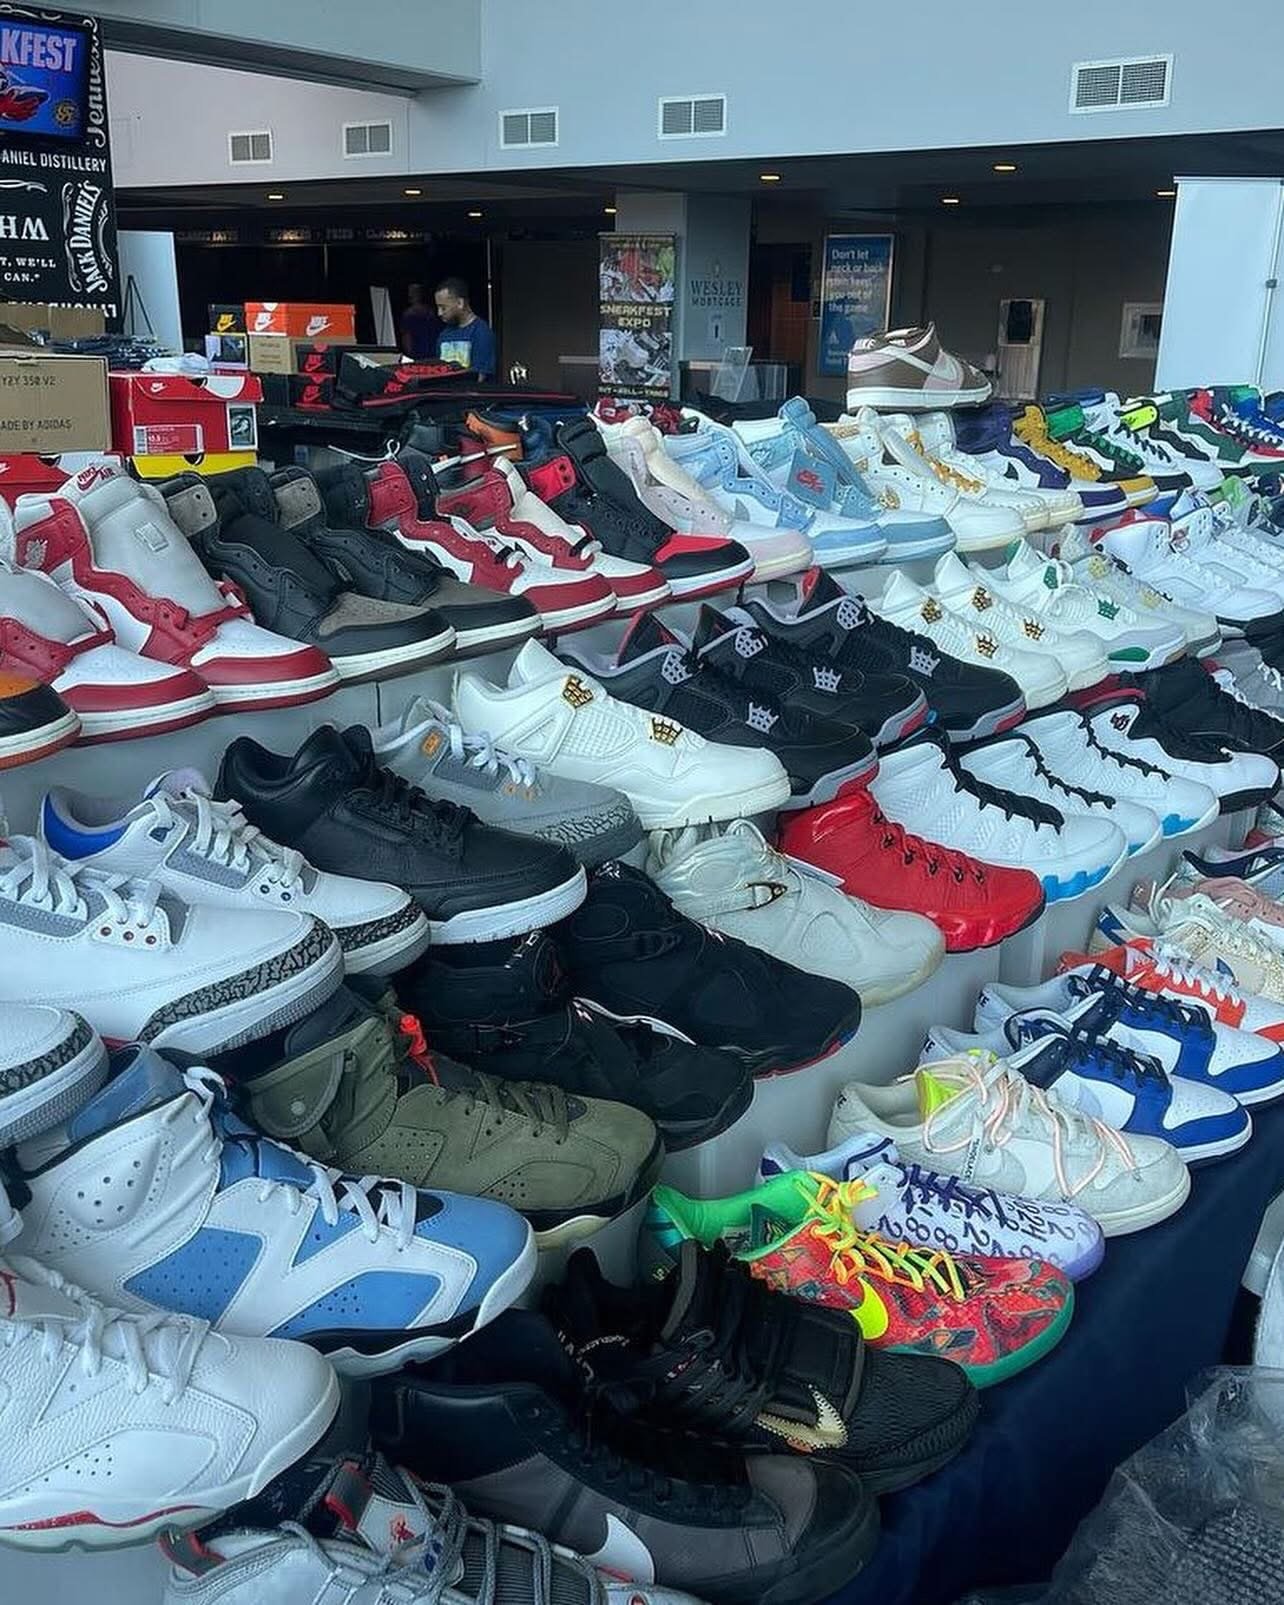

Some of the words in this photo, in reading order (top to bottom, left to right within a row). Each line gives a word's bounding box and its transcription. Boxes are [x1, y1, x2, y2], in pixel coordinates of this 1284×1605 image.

[1, 28, 77, 72] KFEST
[1, 150, 37, 167] ANIEL
[40, 153, 106, 172] DISTILLERY
[69, 180, 102, 249] DANIEL'S
[832, 249, 855, 259] Don't
[857, 249, 869, 260] let
[16, 257, 56, 268] WE'LL
[831, 262, 850, 272] neck
[864, 262, 883, 272] back
[78, 250, 108, 294] JACK
[691, 280, 742, 296] WESLEY
[691, 297, 742, 306] MORTGAGE
[829, 302, 842, 312] the
[600, 304, 672, 317] SNEAKFEST
[618, 317, 651, 328] EXPO
[23, 376, 40, 386] 350
[44, 376, 56, 386] V2
[23, 420, 33, 430] BY
[38, 420, 72, 430] ADIDAS
